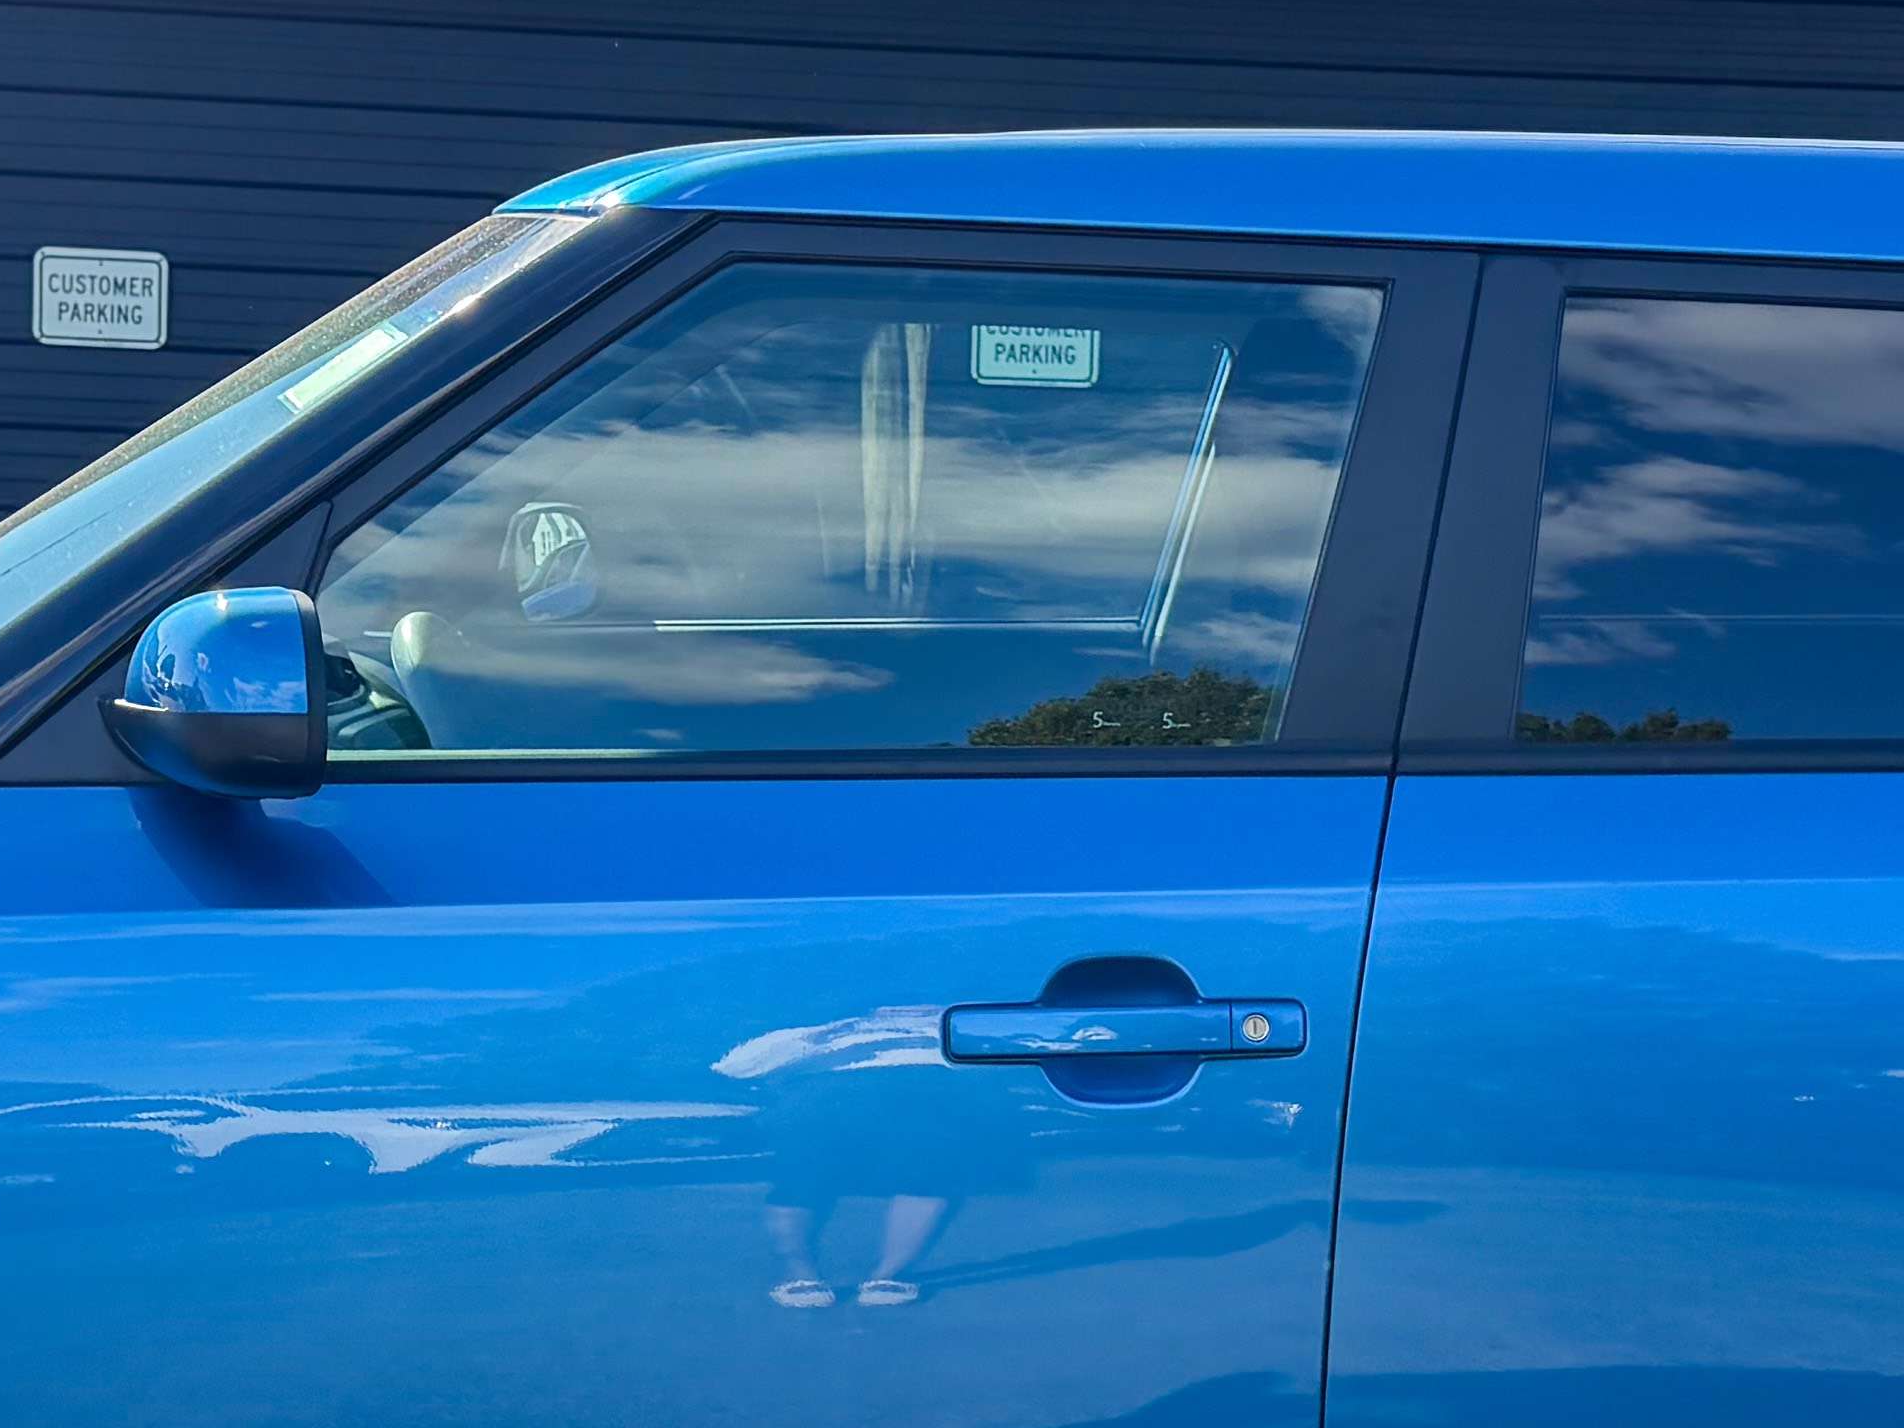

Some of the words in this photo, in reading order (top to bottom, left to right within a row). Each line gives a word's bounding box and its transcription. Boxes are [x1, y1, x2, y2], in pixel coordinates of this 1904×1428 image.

[48, 273, 153, 297] CUSTOMER
[58, 301, 143, 325] PARKING
[994, 343, 1076, 365] PARKING
